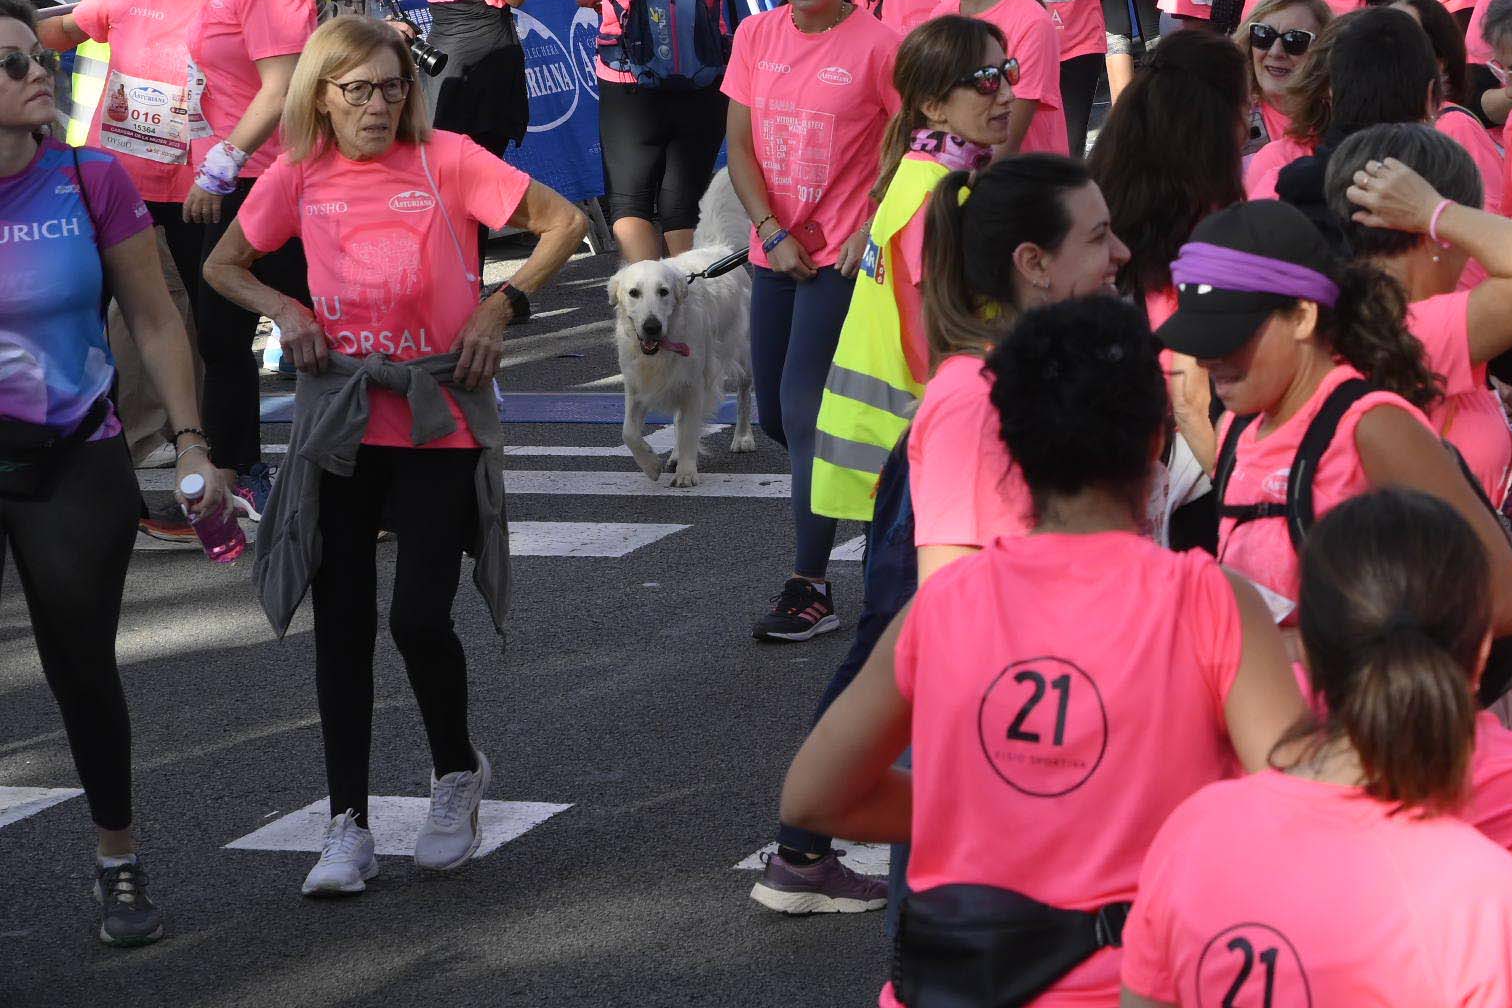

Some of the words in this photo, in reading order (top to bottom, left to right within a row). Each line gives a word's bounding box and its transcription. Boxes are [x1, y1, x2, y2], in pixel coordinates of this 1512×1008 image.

[525, 61, 576, 100] RIANA
[131, 109, 162, 125] 016
[133, 123, 157, 134] 15364
[306, 201, 348, 217] OYSHO
[0, 217, 81, 243] URICH
[312, 295, 343, 321] TU
[334, 328, 433, 355] ORSAL
[1006, 669, 1072, 747] 21
[1221, 936, 1280, 1008] 21
